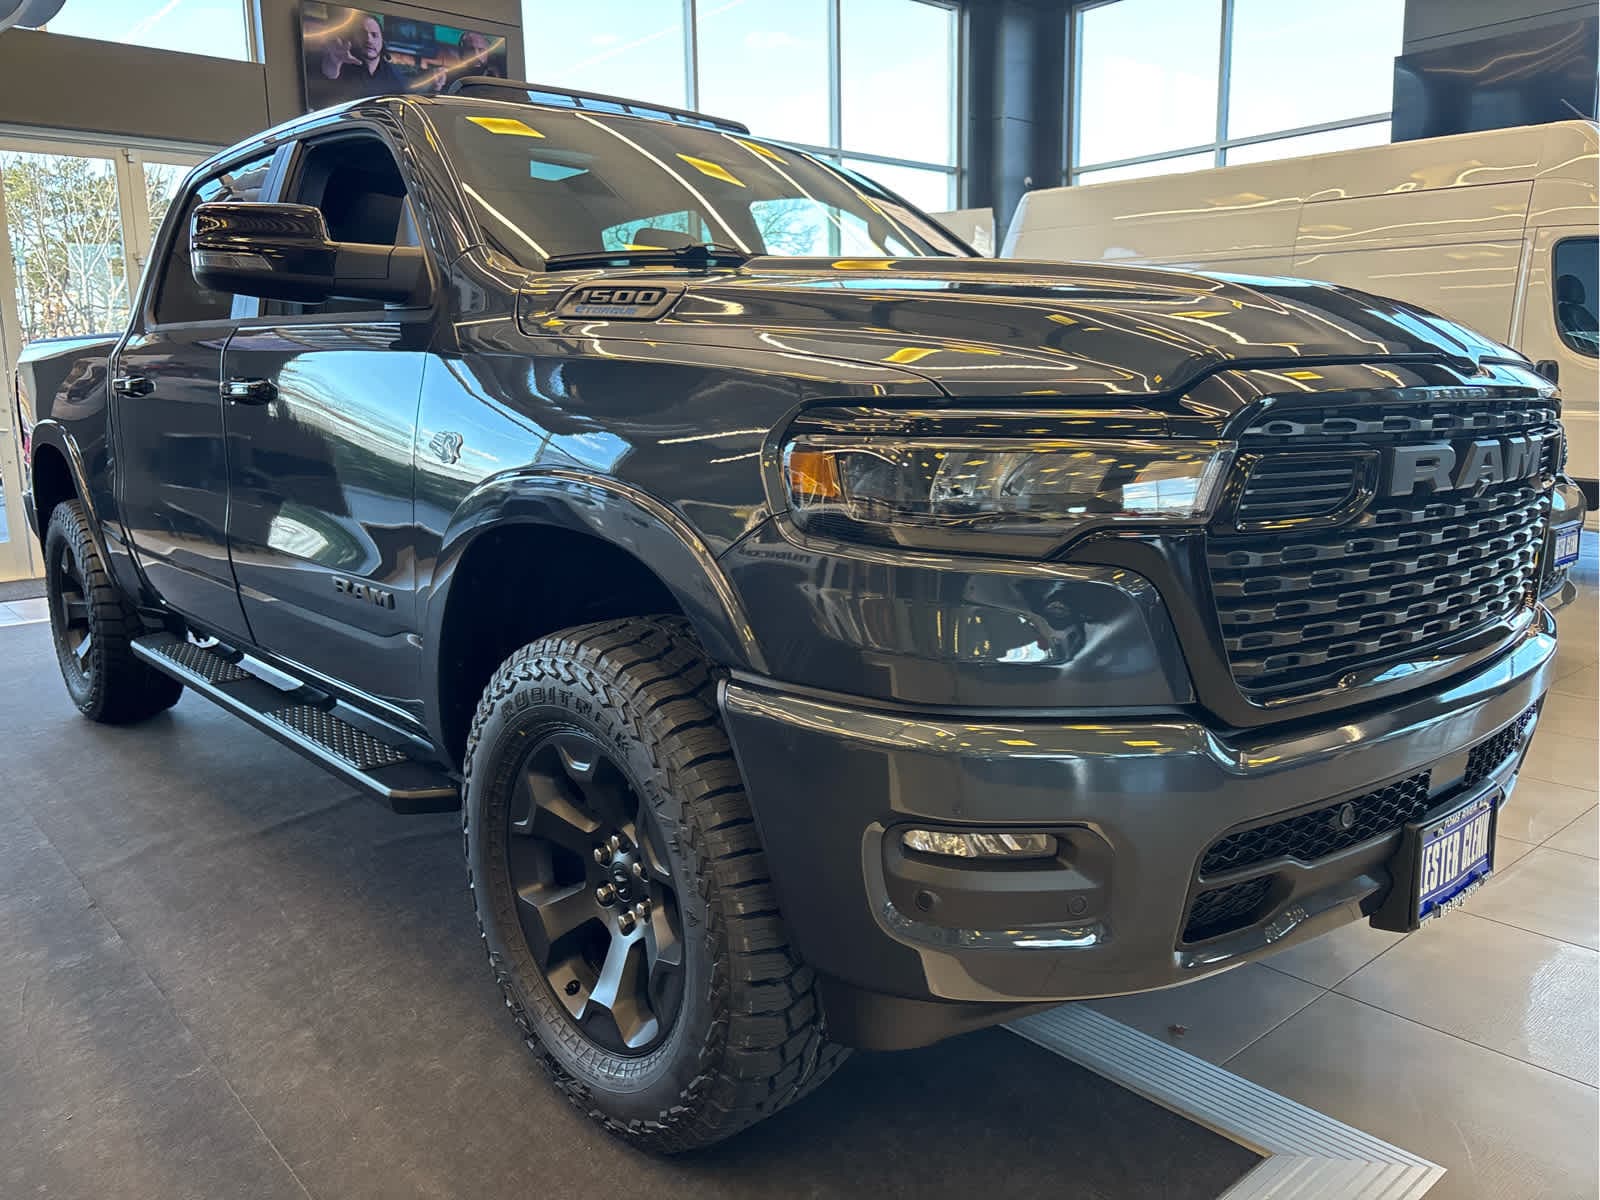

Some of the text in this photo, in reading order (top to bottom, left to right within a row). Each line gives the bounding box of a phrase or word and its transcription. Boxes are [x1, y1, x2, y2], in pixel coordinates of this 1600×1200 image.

[580, 289, 661, 304] 1500
[1391, 435, 1543, 497] RAM
[332, 576, 395, 609] RAM
[1461, 809, 1491, 872] GLENN
